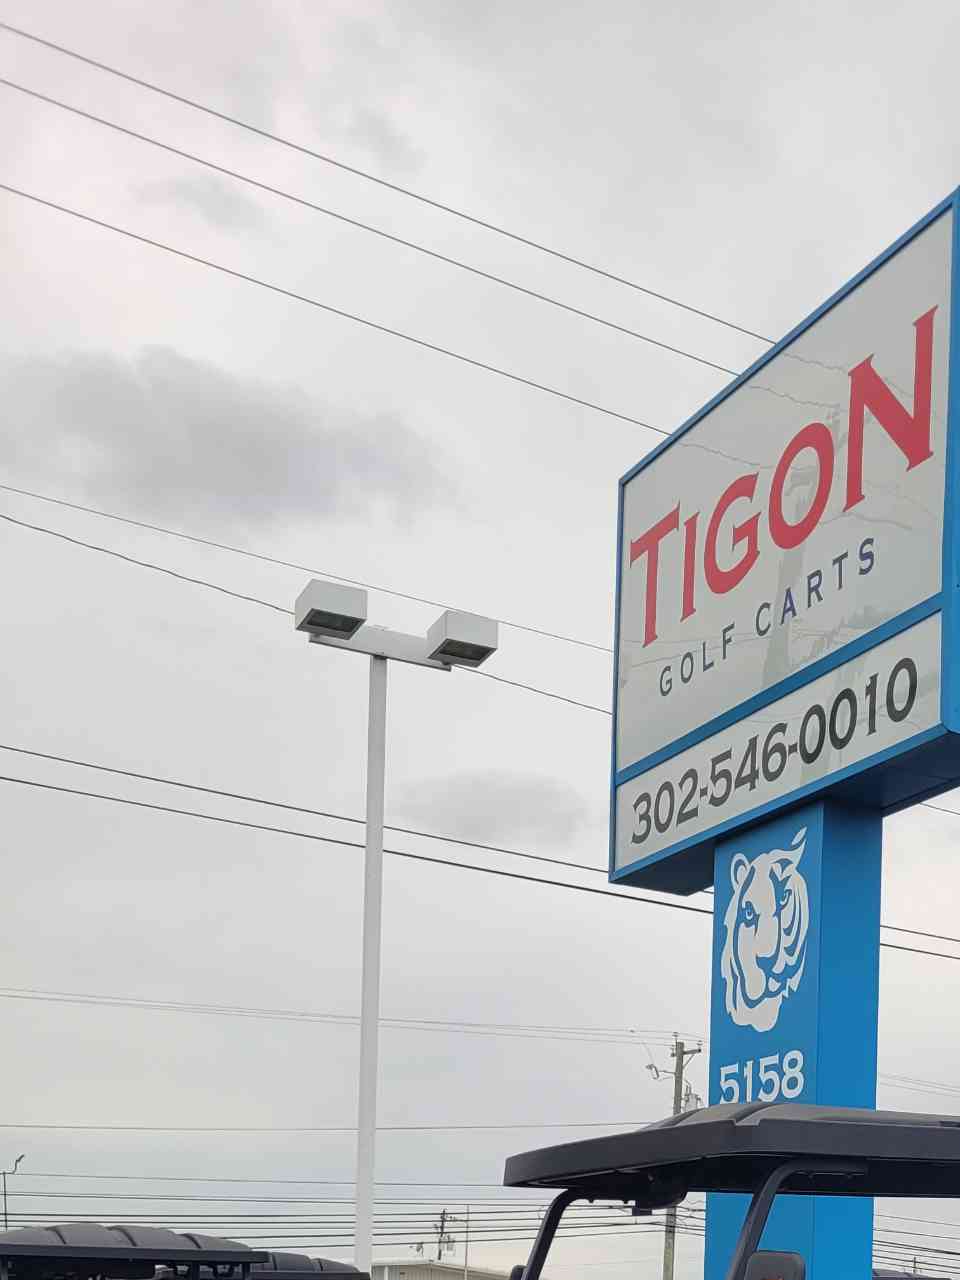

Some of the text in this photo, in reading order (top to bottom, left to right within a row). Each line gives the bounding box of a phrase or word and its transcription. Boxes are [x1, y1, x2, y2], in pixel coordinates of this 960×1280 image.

[629, 304, 938, 647] TIGON
[659, 537, 876, 697] GOLF CARTS
[631, 657, 918, 845] 302-546-0010
[720, 1050, 804, 1104] 5158
